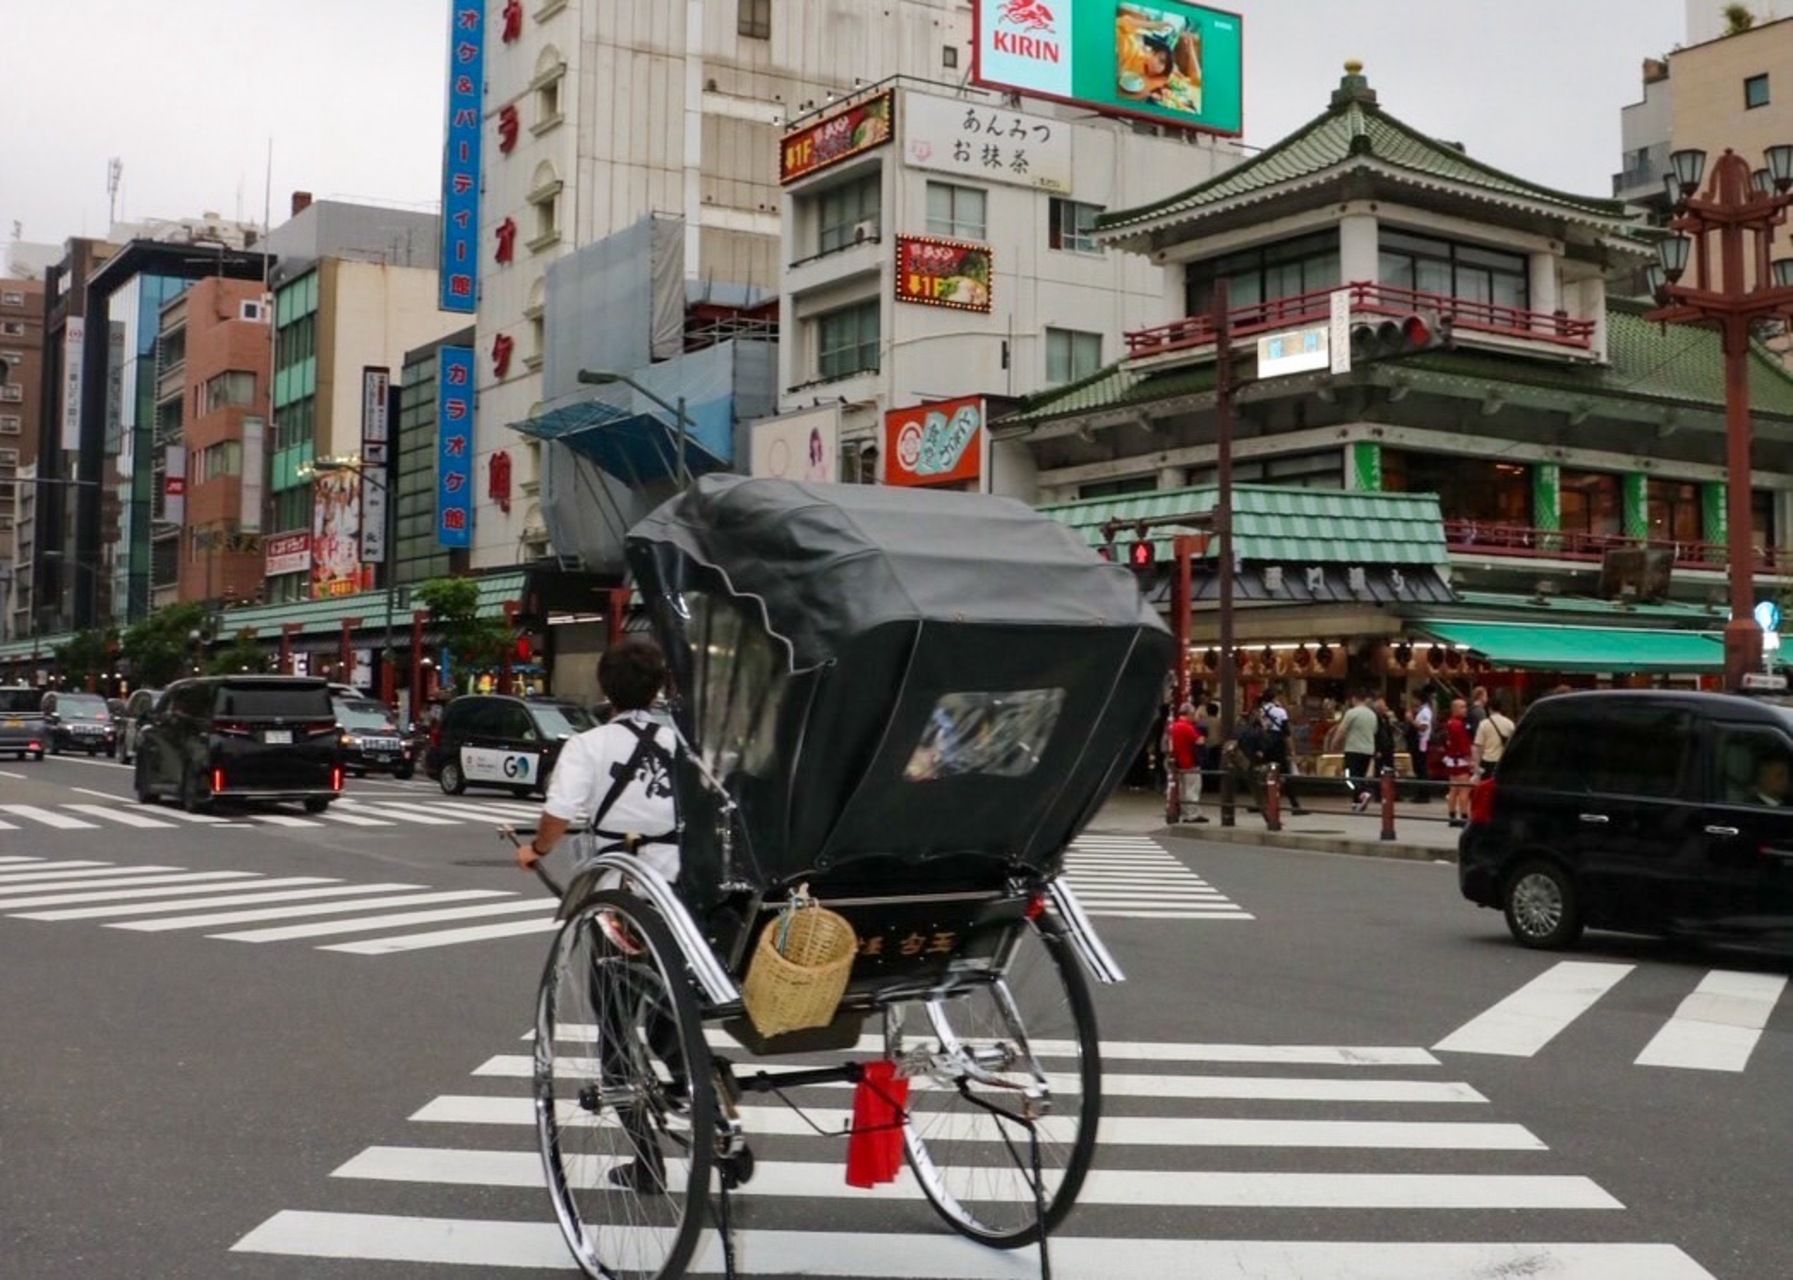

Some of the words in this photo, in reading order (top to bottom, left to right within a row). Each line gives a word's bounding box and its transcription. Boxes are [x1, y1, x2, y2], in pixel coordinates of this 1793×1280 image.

[993, 30, 1060, 63] KIRIN
[963, 108, 1052, 142] あんみつ
[953, 139, 1030, 174] お抹茶
[444, 362, 467, 530] カラオケ館
[503, 755, 530, 779] GO
